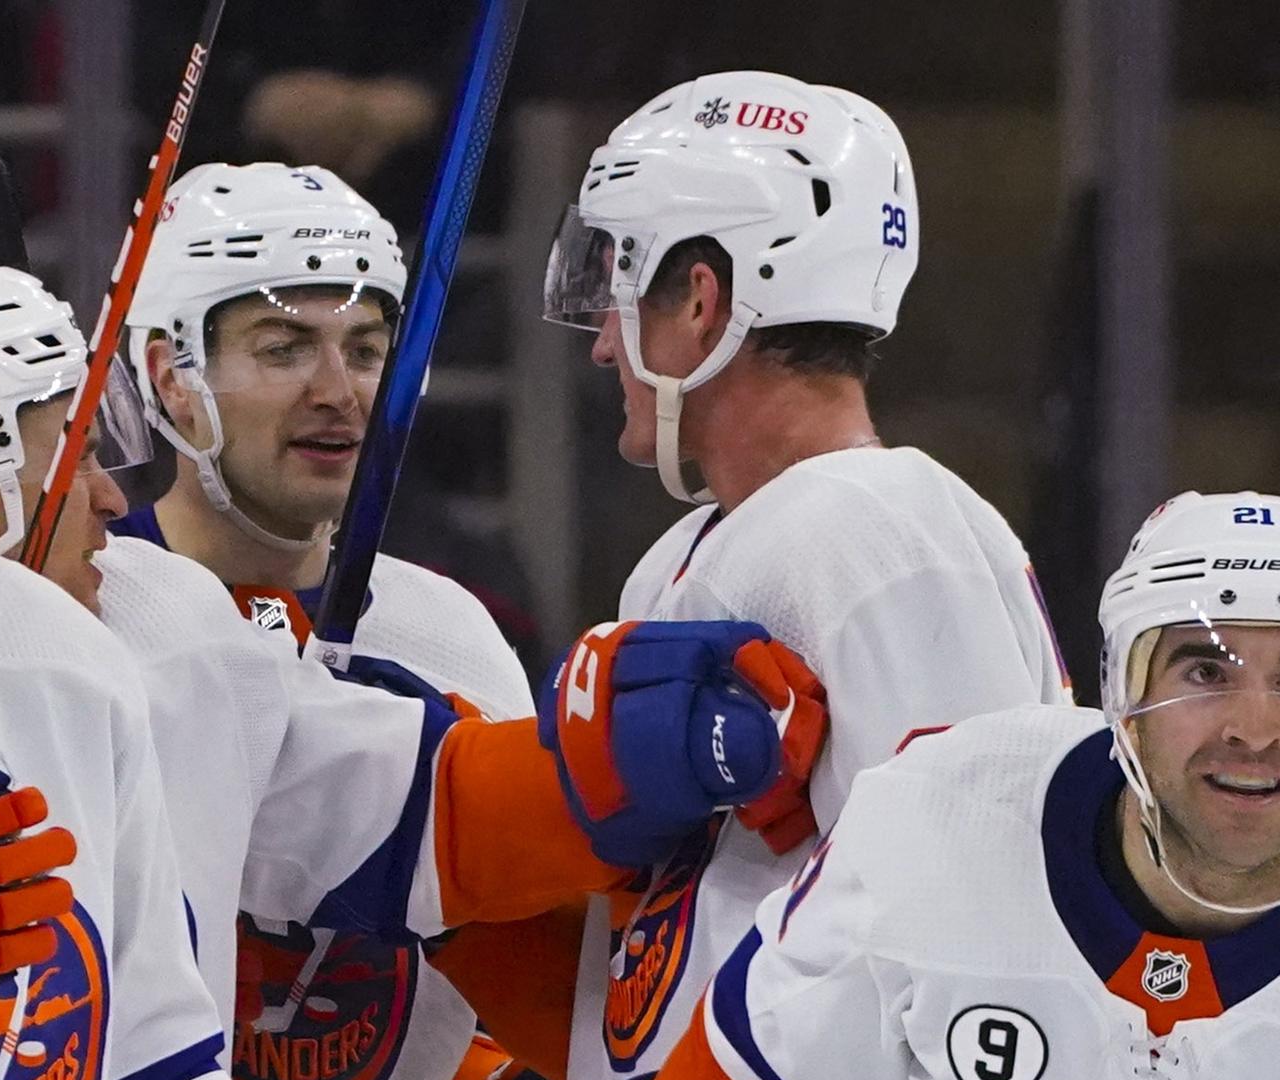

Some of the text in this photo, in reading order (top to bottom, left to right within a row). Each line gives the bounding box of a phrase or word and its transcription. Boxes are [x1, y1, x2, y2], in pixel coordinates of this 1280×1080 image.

[166, 42, 207, 144] BAUER
[735, 102, 808, 135] UBS
[291, 173, 323, 191] 3
[881, 203, 907, 249] 29
[1233, 507, 1274, 525] 21
[712, 714, 736, 784] CCM
[1152, 966, 1180, 988] NHL
